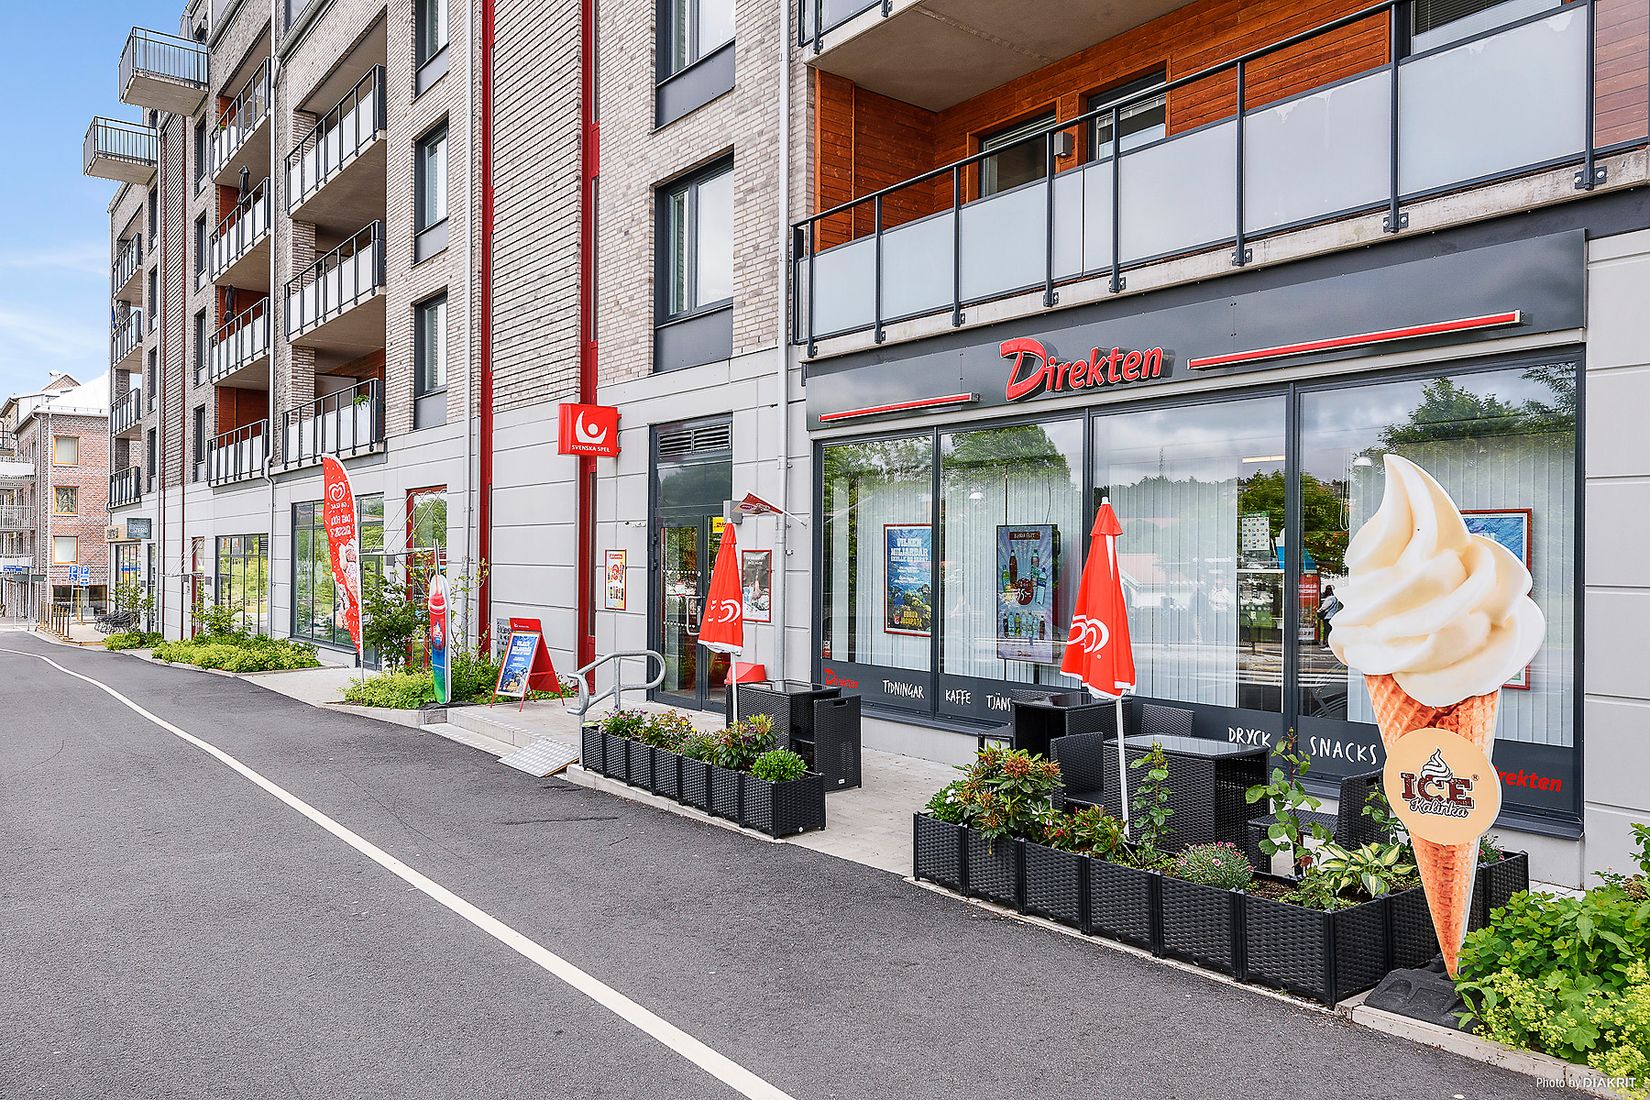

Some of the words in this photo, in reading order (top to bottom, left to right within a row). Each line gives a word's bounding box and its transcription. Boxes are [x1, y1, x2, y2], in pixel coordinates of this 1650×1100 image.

[999, 337, 1164, 402] Direkten
[571, 444, 597, 452] SVENSKA
[882, 679, 925, 699] TIDNINGAR
[945, 689, 972, 705] KAFFE
[985, 692, 1012, 712] TJÄNS
[1227, 726, 1272, 748] DRYCK
[1309, 735, 1377, 765] SNACKS
[1494, 765, 1562, 793] rekten
[1400, 771, 1475, 809] ICE
[1409, 798, 1469, 818] Kalinka
